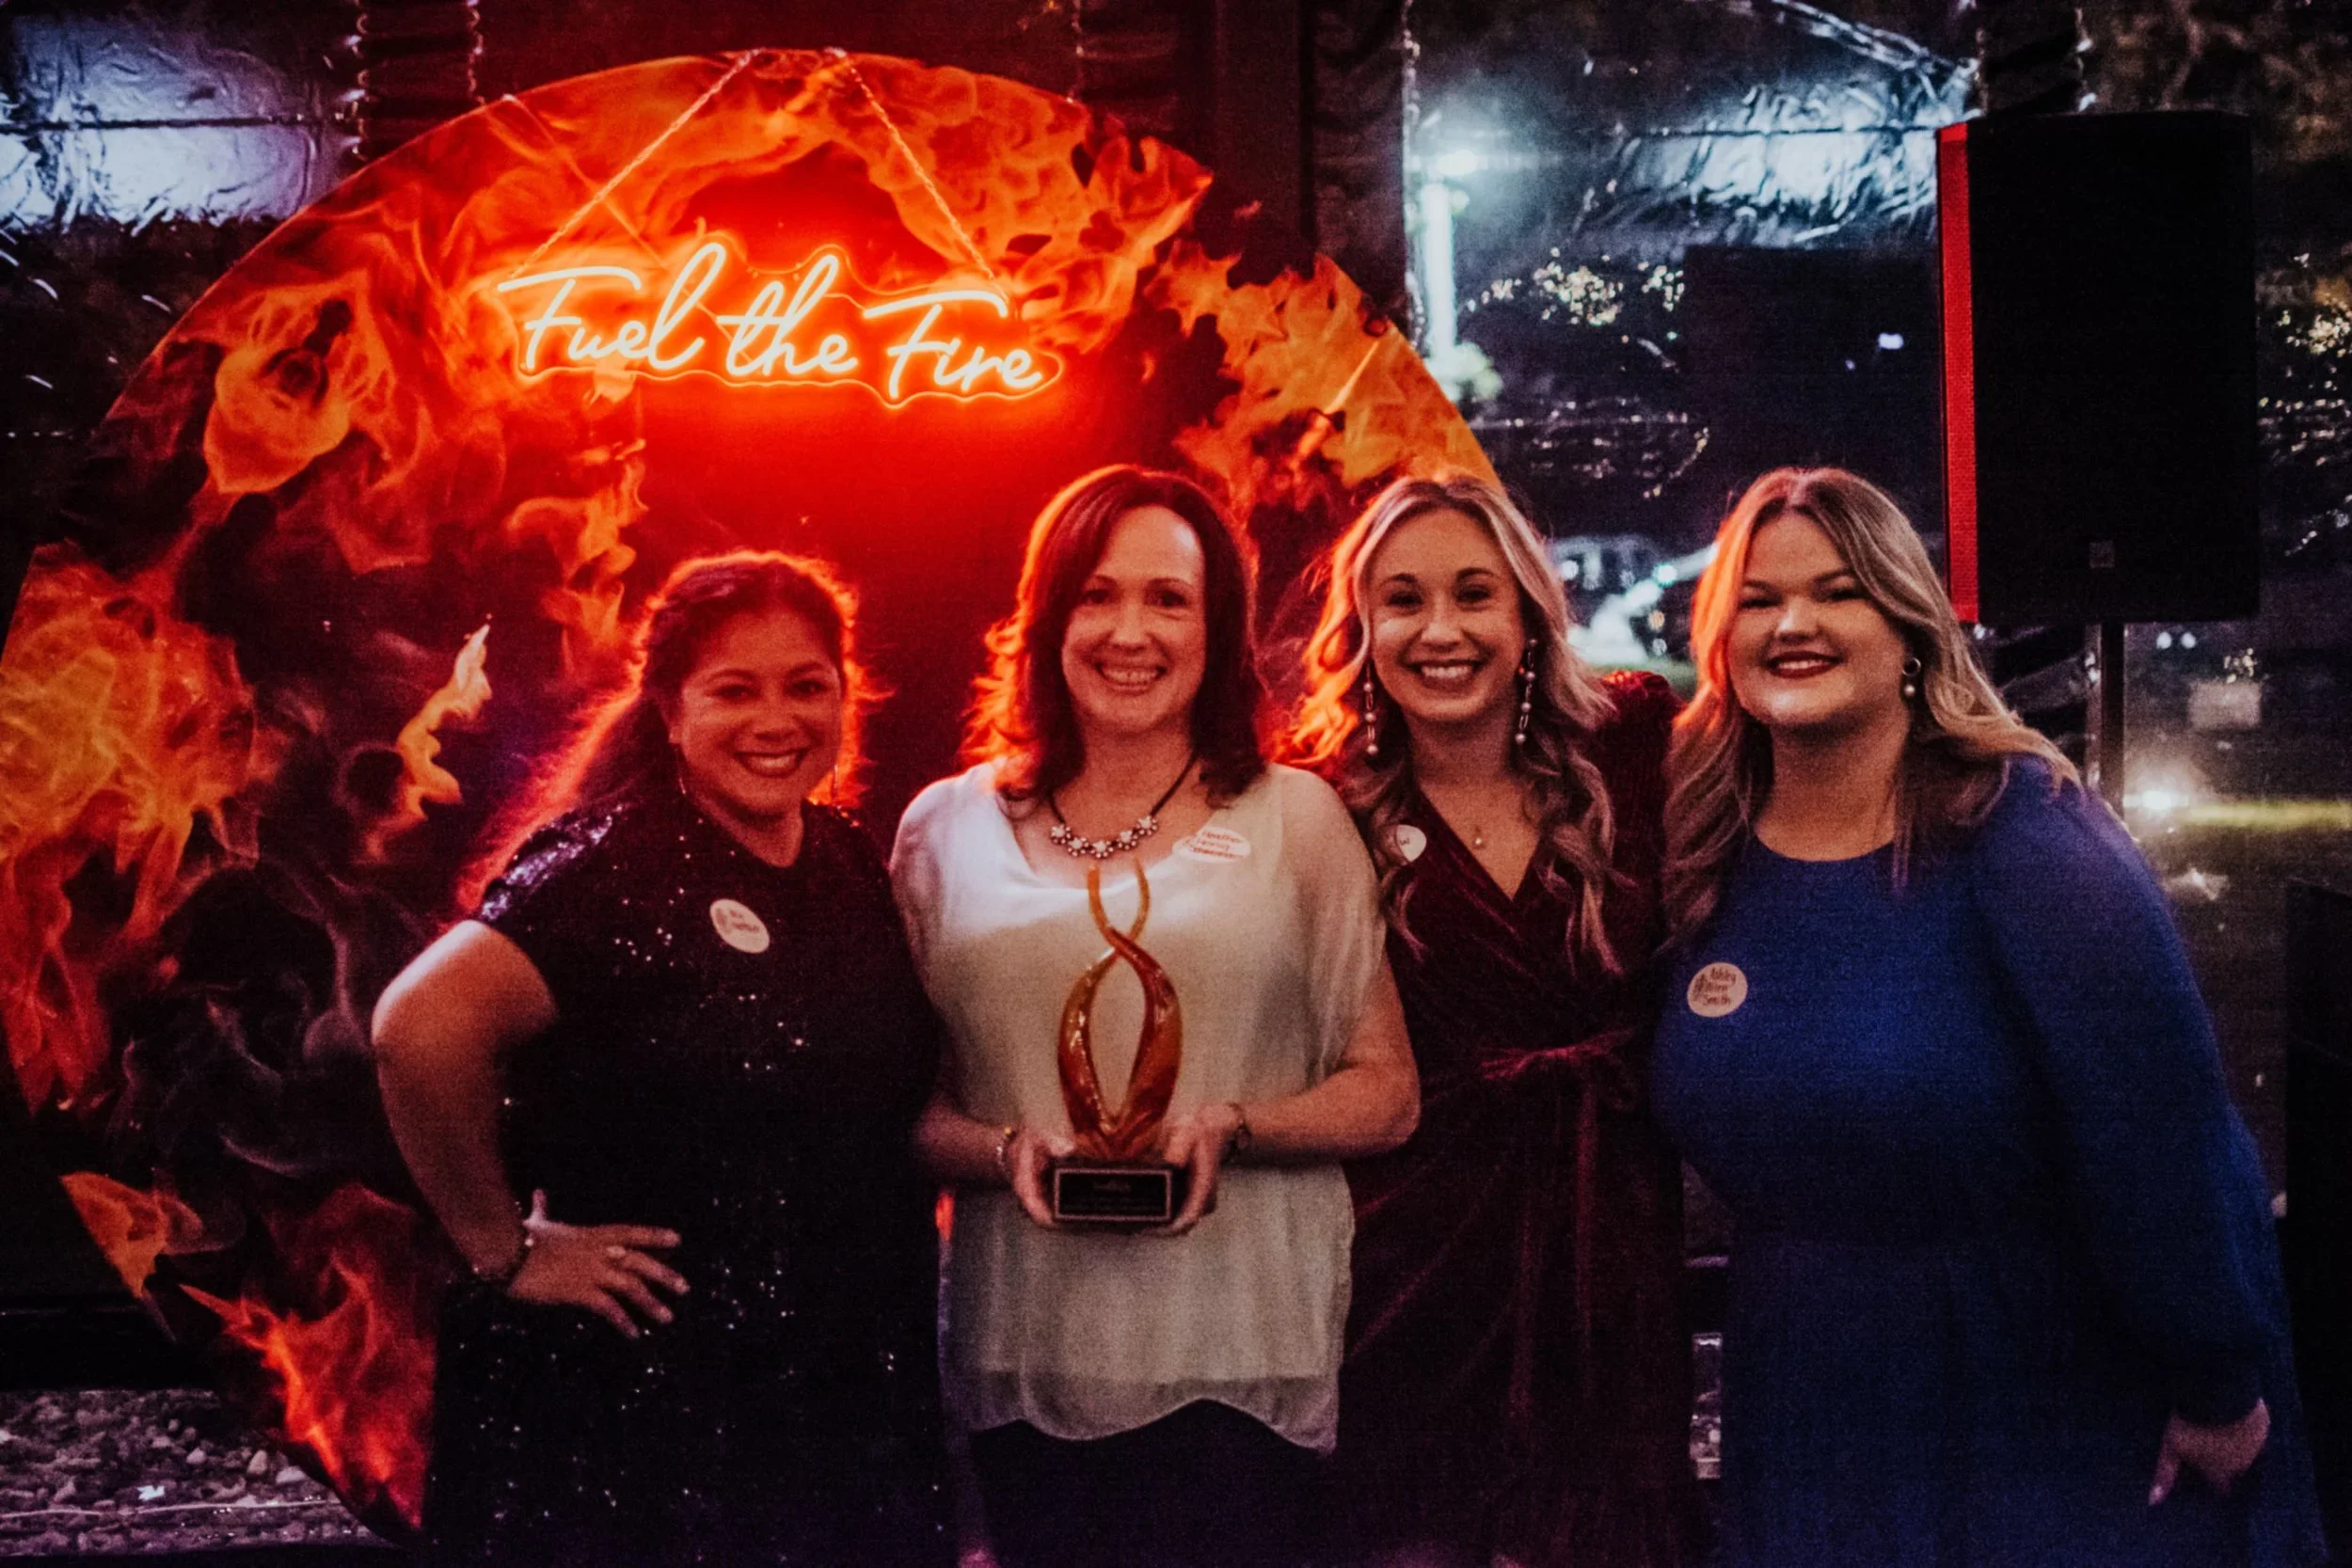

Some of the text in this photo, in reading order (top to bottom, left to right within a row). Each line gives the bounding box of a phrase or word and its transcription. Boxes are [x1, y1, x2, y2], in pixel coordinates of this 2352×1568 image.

[498, 242, 1043, 399] Fuel the Fire
